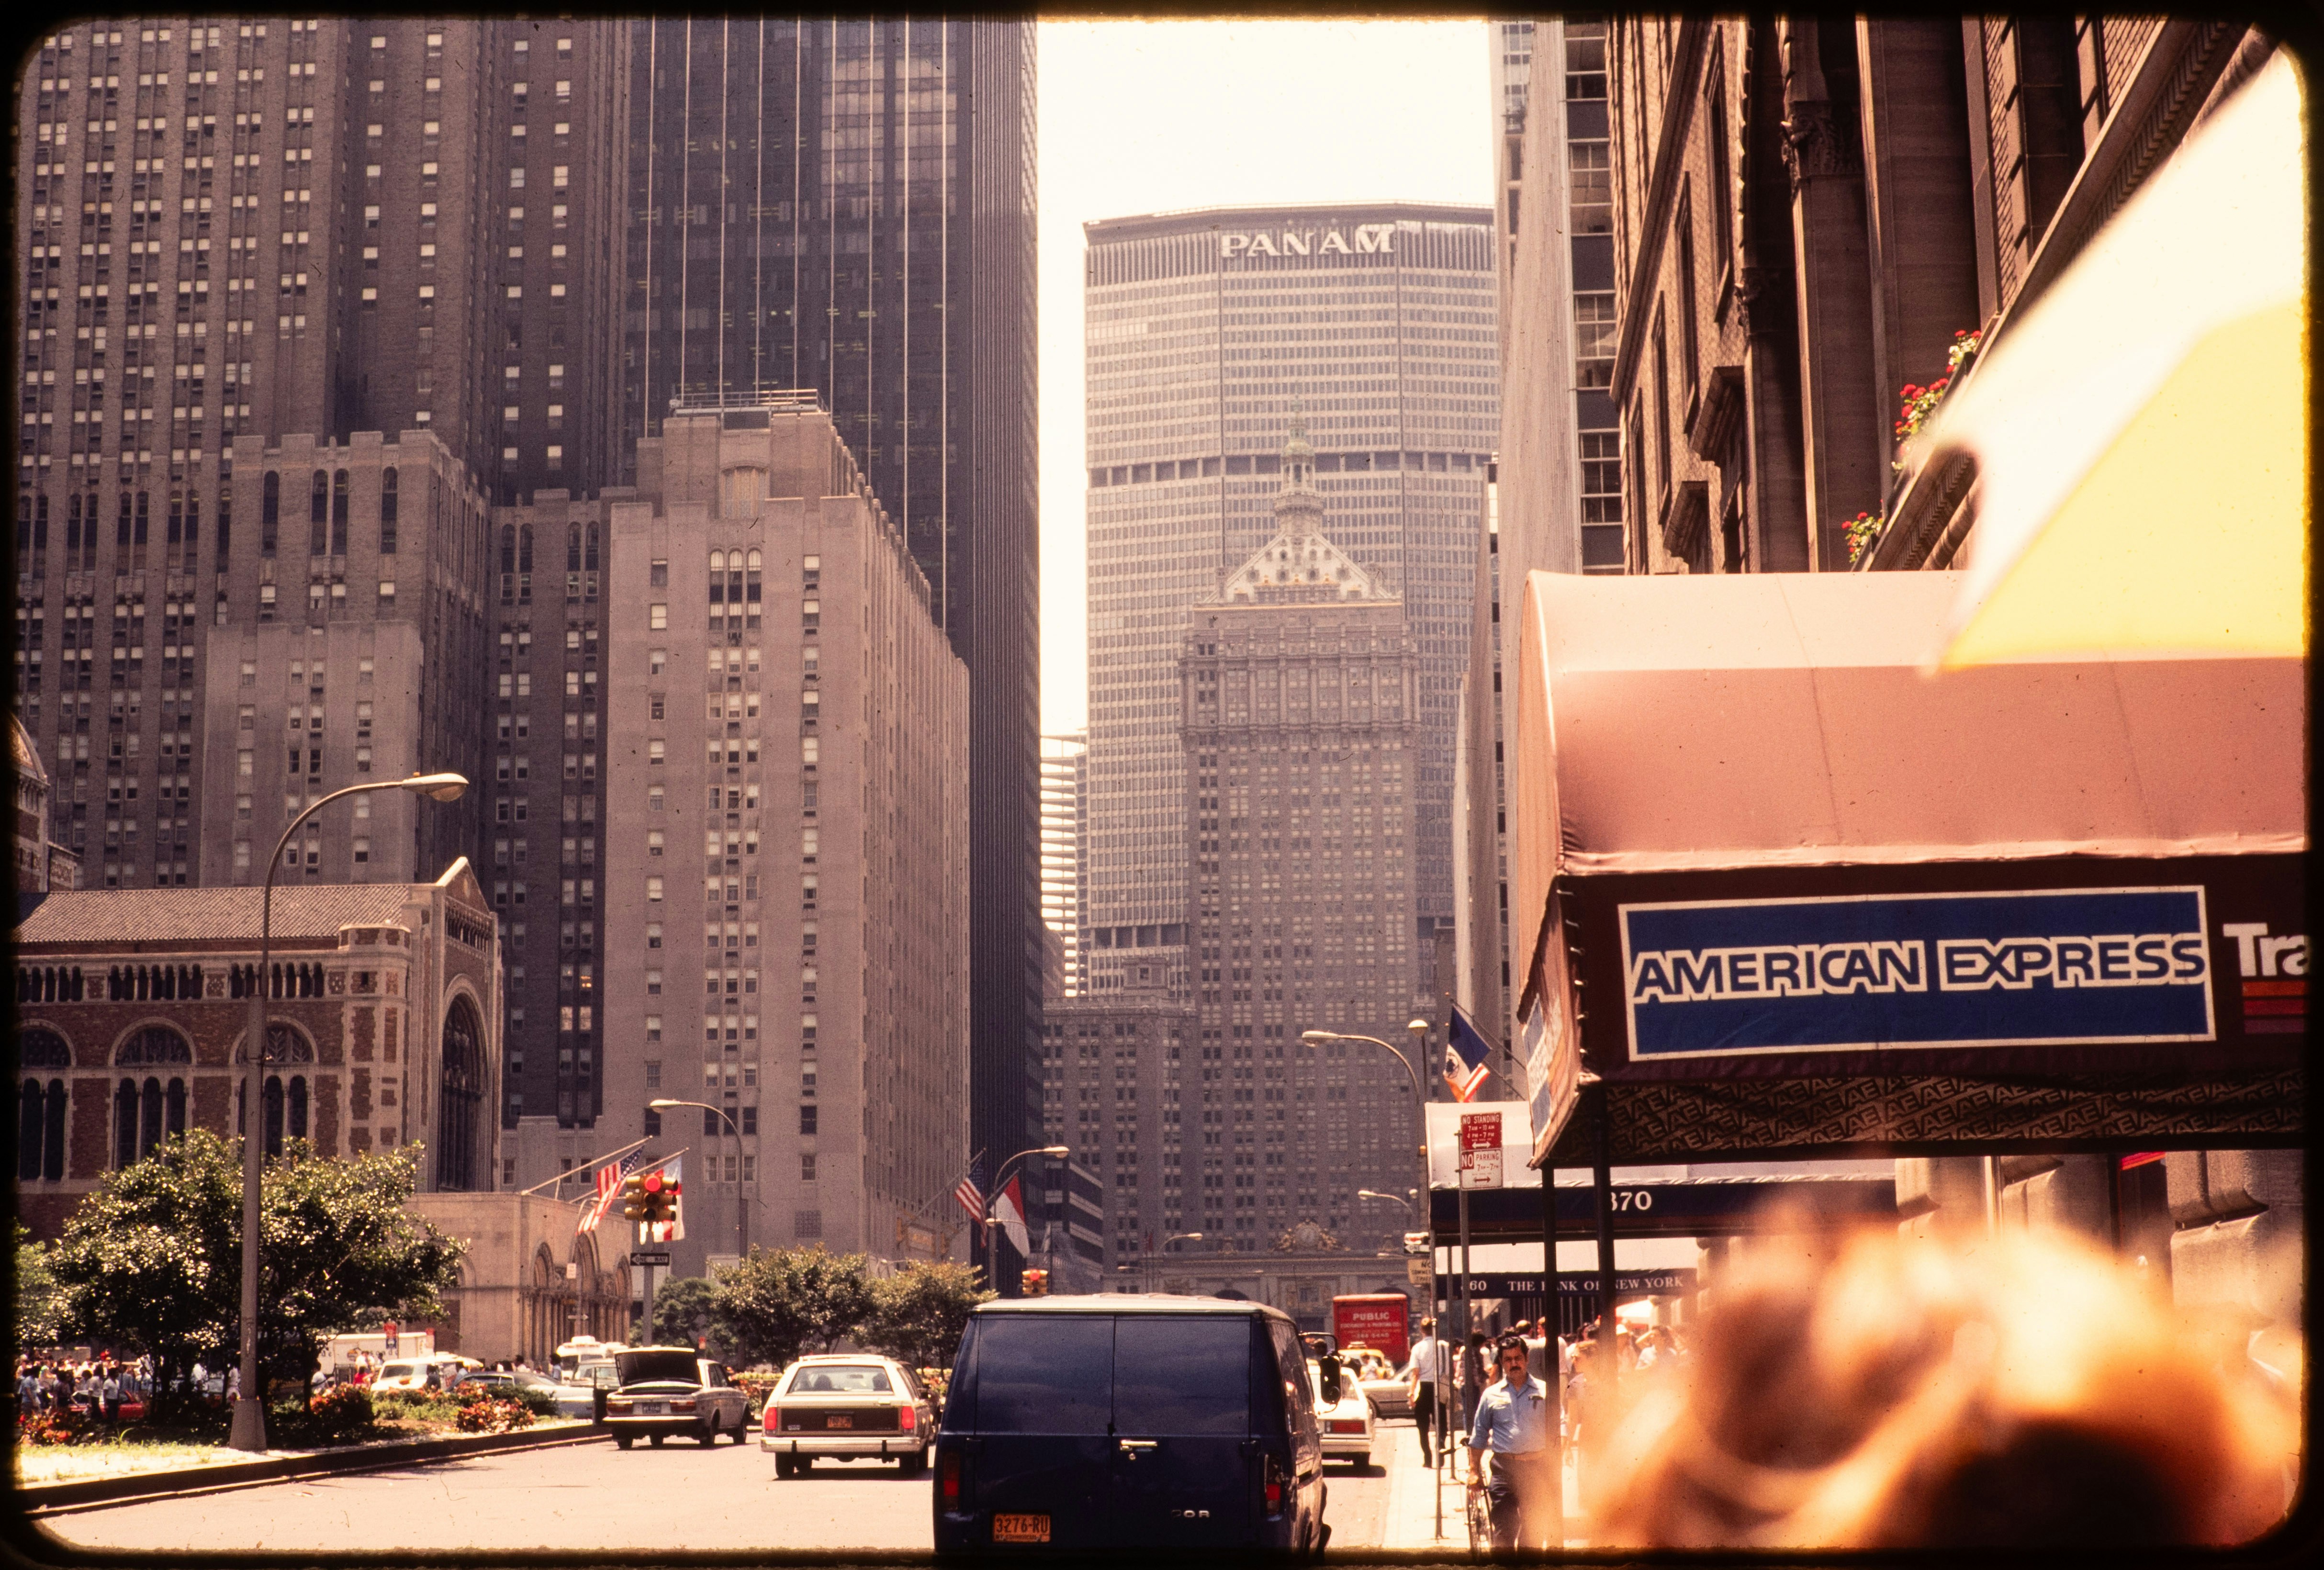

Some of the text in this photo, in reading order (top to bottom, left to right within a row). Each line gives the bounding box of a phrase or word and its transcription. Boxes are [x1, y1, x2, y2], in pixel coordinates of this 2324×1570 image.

[2223, 923, 2311, 977] Tra
[1631, 933, 2205, 1003] AMERICAN EXPRESS
[1635, 1091, 1664, 1119] AE
[1777, 1084, 1807, 1111] AE
[1848, 1081, 1879, 1107] AE
[1923, 1078, 1955, 1106] AE
[1959, 1092, 1990, 1119] AE
[1463, 1115, 1499, 1124] NO STANDING
[1670, 1104, 1701, 1131] AE
[1813, 1097, 1843, 1123] AE
[1849, 1108, 1880, 1135] AE
[1887, 1094, 1919, 1122] AE
[1923, 1106, 1955, 1134] AE
[1997, 1105, 2028, 1131] AE
[2068, 1104, 2099, 1130] AE
[1636, 1121, 1665, 1144] AE
[1708, 1112, 1737, 1142] AE
[1779, 1111, 1808, 1139] AE
[1461, 1154, 1473, 1167] NO
[1461, 1280, 1487, 1291] 60
[1507, 1281, 1535, 1291] THE
[1541, 1281, 1578, 1291] NK
[1645, 1277, 1683, 1288] YORK
[1353, 1312, 1390, 1321] PUBLIC
[996, 1516, 1048, 1533] 3276-RU
